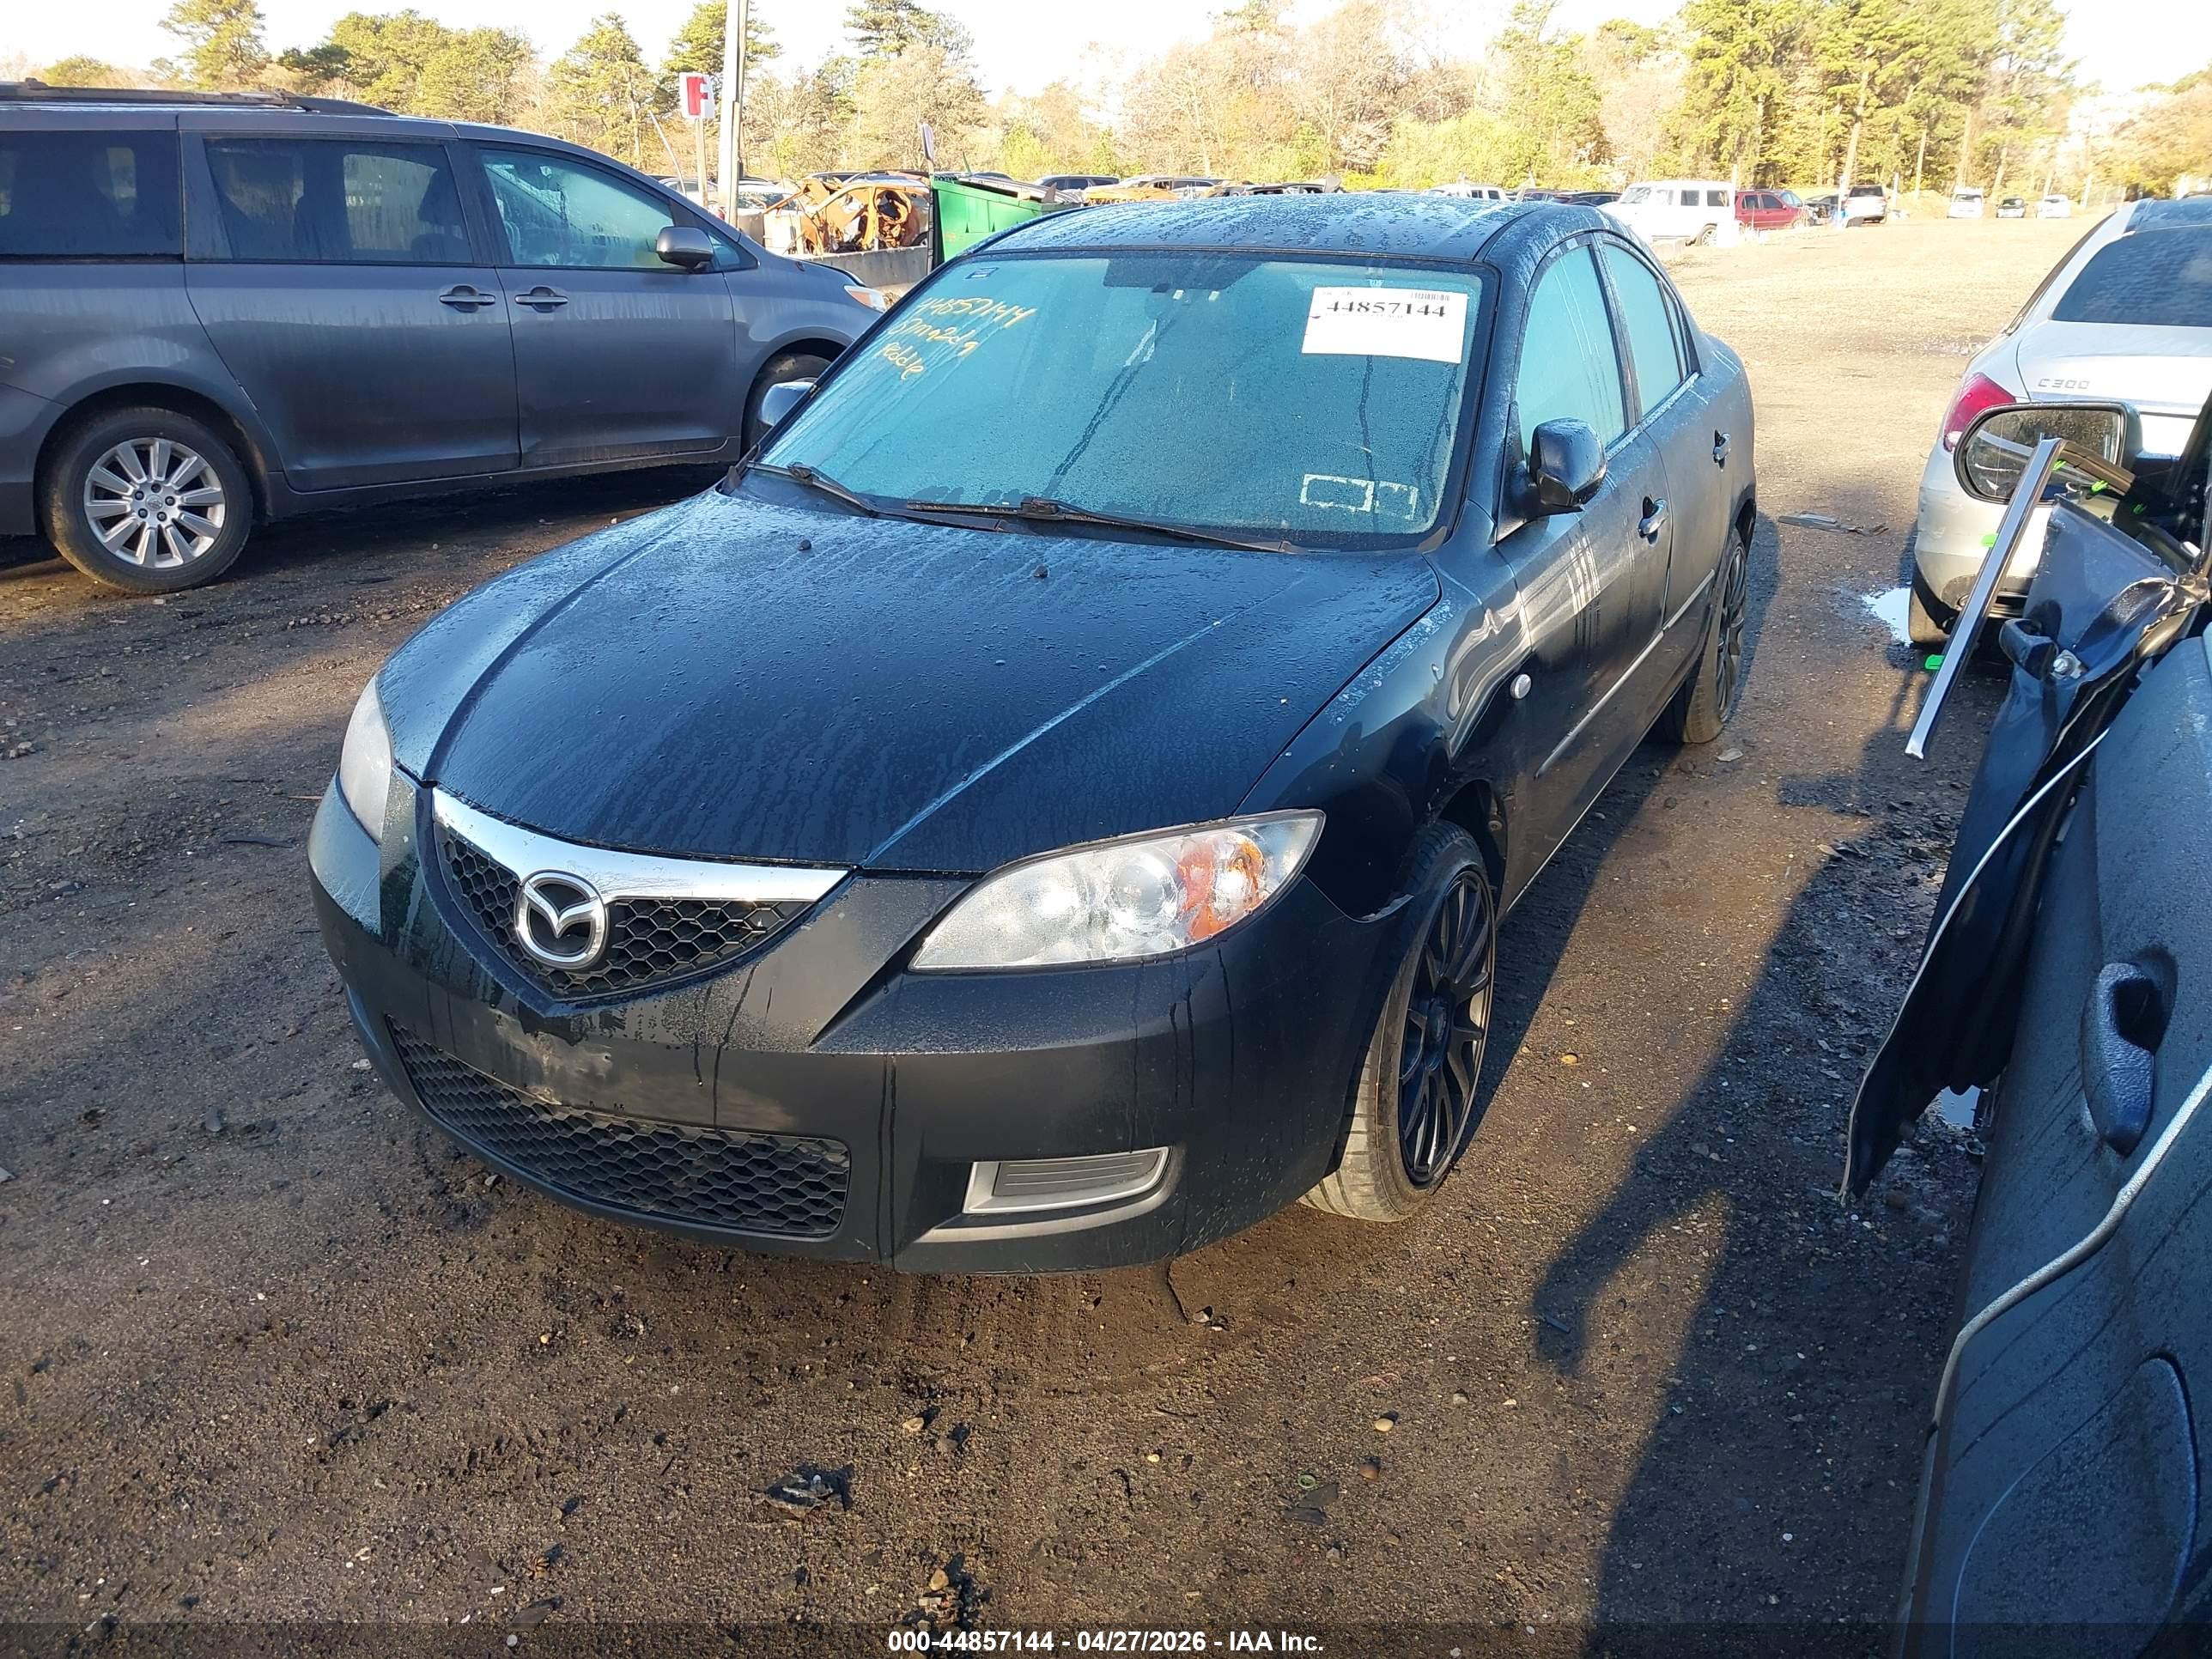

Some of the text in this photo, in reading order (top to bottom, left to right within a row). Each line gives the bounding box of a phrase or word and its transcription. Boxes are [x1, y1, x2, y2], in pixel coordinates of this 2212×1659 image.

[917, 297, 1037, 328] 44857144
[1327, 301, 1447, 318] 44857144
[2038, 379, 2090, 389] C 300
